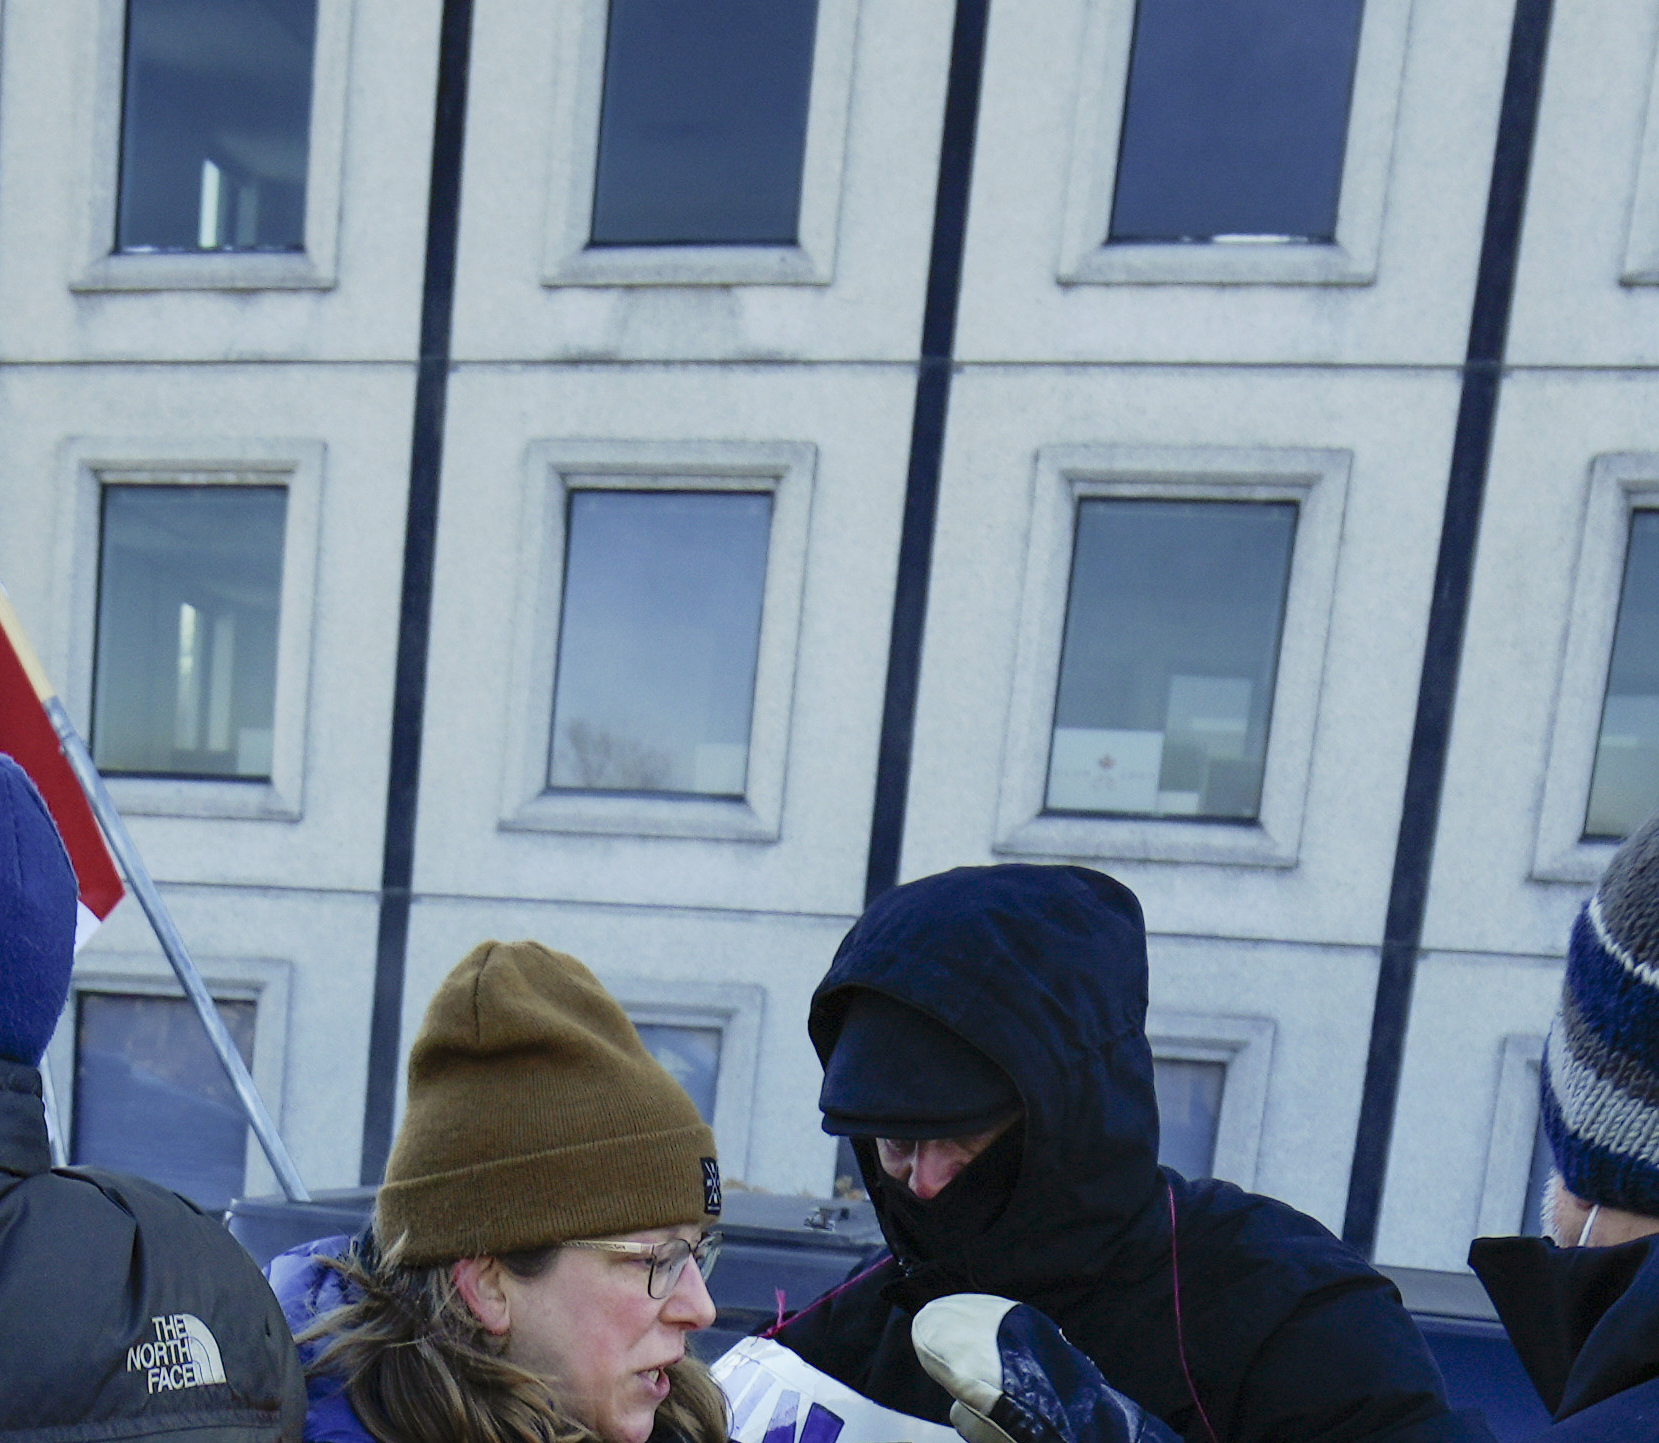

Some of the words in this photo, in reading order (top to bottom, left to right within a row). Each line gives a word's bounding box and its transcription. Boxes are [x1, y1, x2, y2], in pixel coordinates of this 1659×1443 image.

[151, 1313, 188, 1341] THE
[126, 1338, 193, 1373] NORTH
[147, 1362, 197, 1395] FACE
